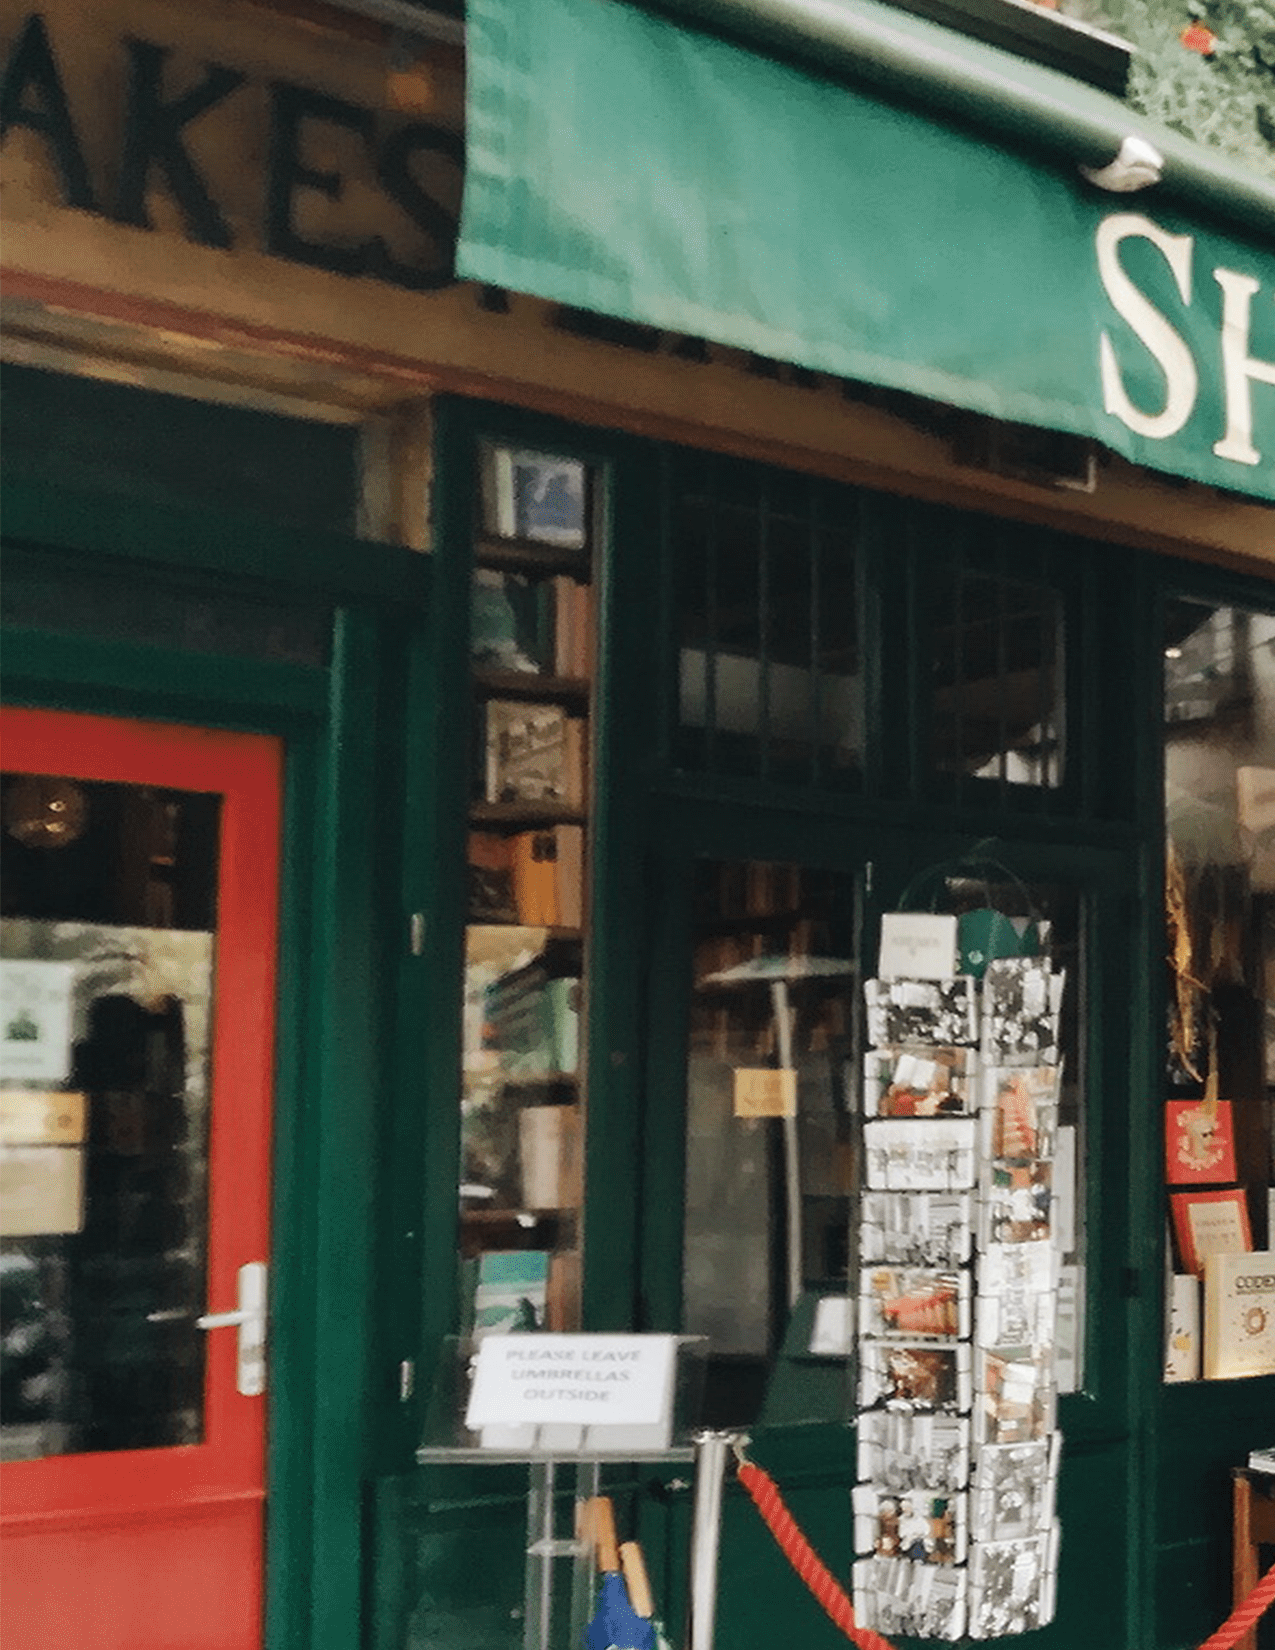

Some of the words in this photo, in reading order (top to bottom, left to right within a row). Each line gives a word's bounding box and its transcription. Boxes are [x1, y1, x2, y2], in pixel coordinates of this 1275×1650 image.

[505, 1349, 576, 1362] PLEASE
[581, 1349, 642, 1362] LEAVE
[510, 1368, 631, 1382] UMBRELLAS
[523, 1388, 611, 1401] OUTSIDE
